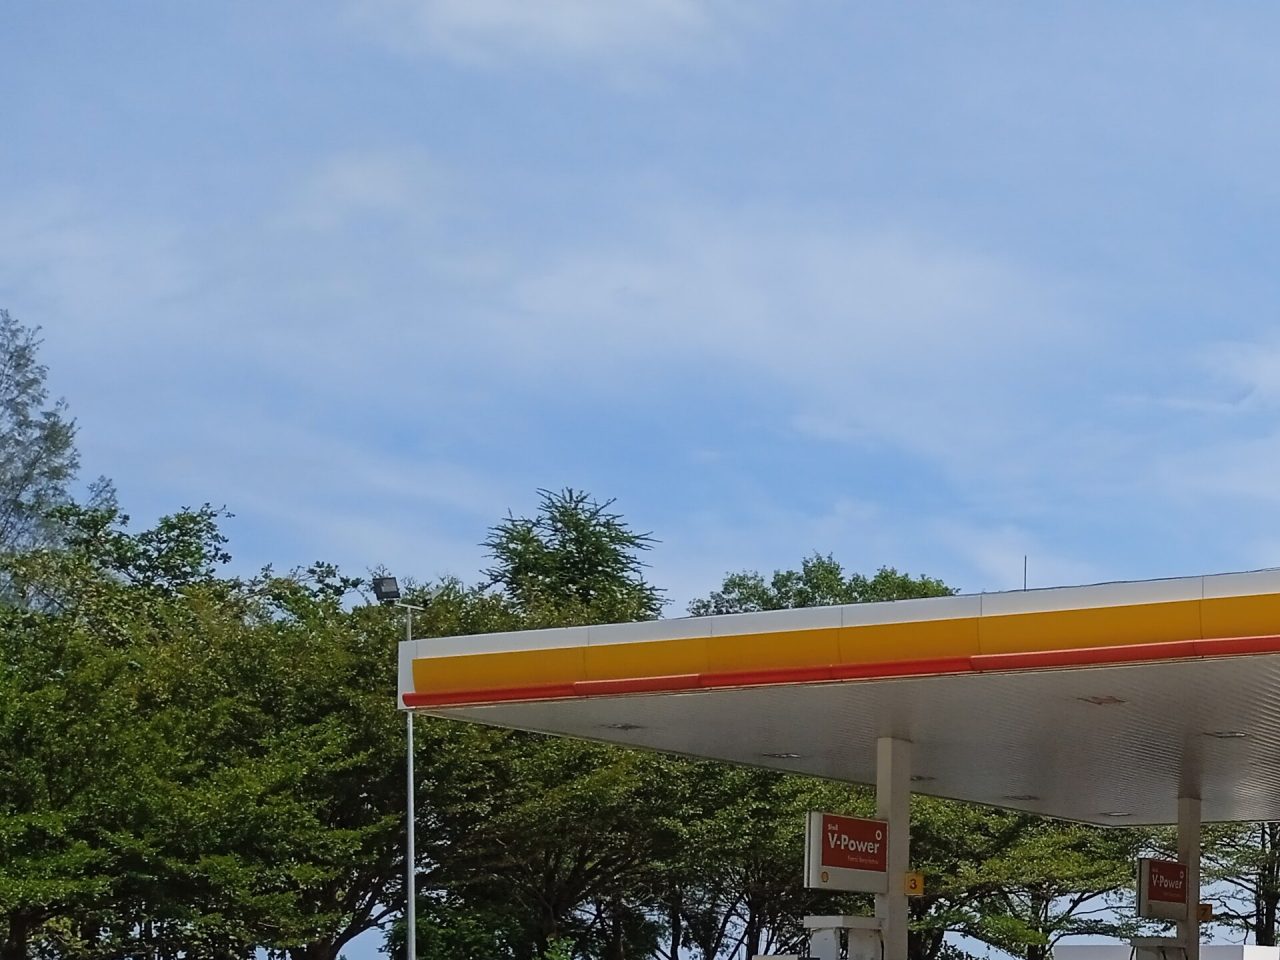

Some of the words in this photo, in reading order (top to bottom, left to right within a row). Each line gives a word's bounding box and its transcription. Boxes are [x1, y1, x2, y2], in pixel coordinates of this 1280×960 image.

[827, 832, 880, 854] V-Power
[909, 878, 918, 890] 3
[1152, 873, 1183, 889] V-Power
